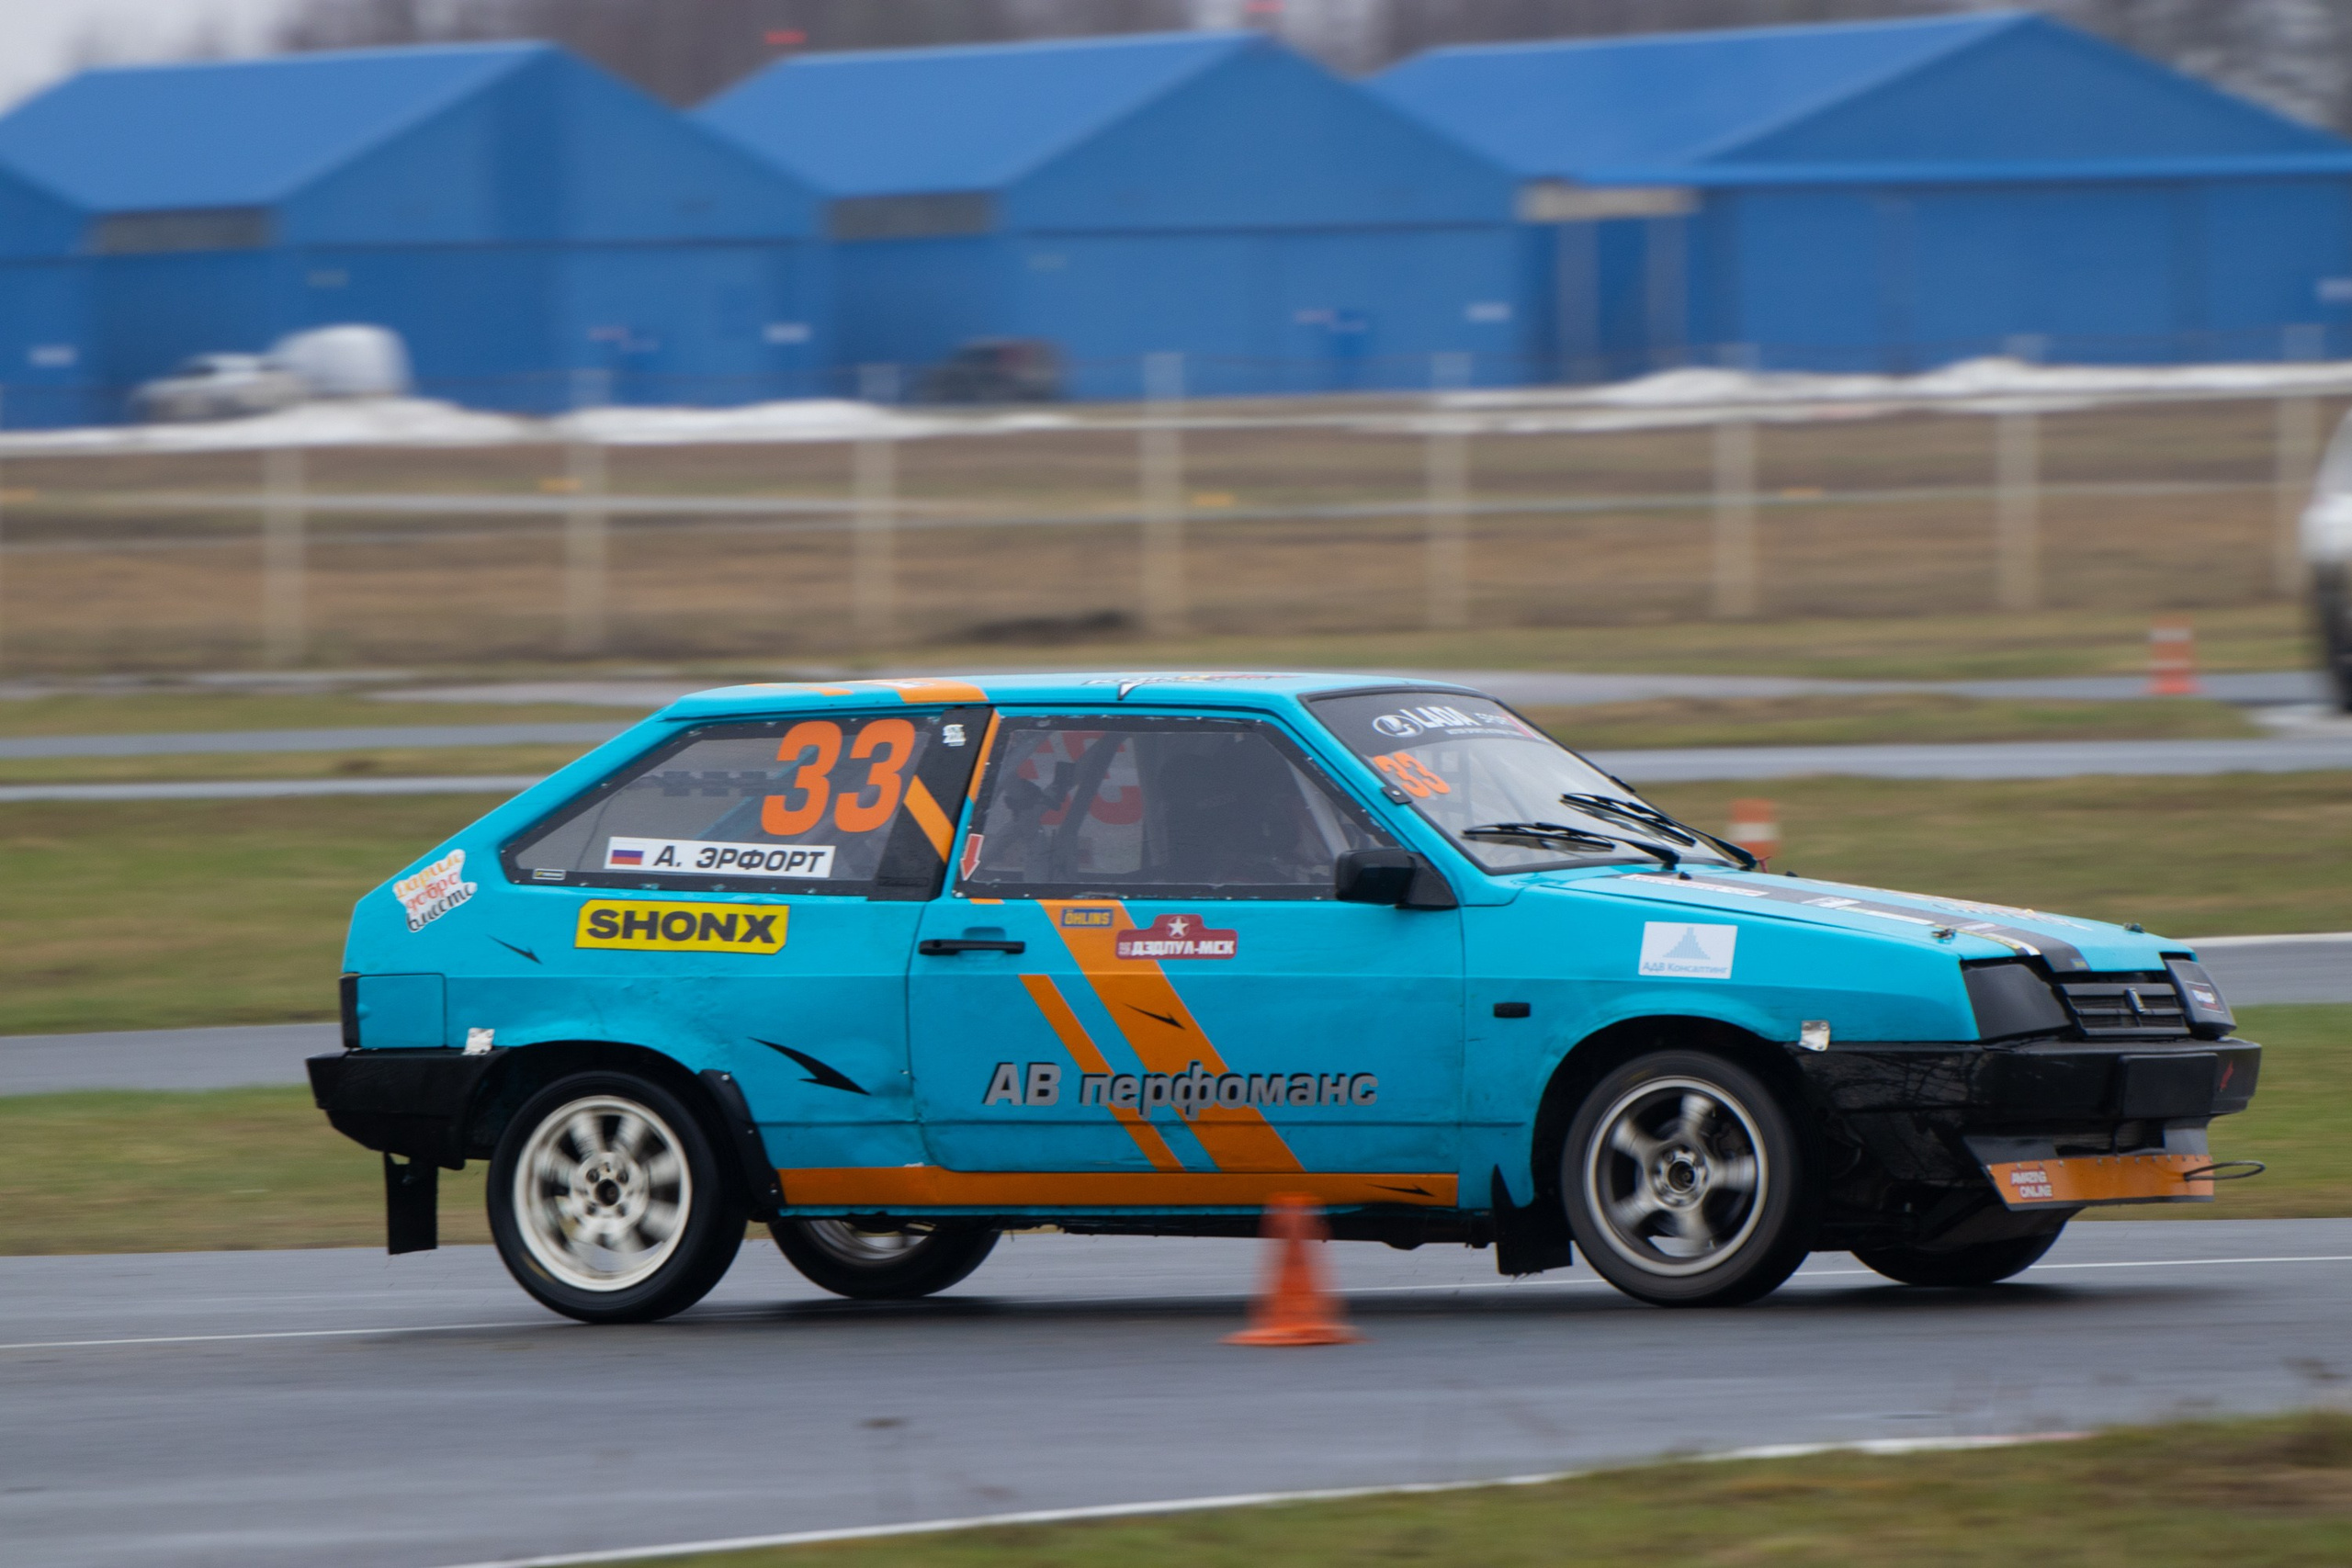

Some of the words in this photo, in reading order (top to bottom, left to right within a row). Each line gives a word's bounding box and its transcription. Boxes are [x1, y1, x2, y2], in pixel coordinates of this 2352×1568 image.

[1398, 706, 1481, 728] LADA
[761, 718, 916, 836] 33
[1373, 751, 1451, 798] 33
[653, 845, 682, 867] А.
[695, 847, 825, 873] ЭРФОРТ
[586, 908, 777, 943] SHONX
[1079, 1060, 1378, 1120] перфоманс
